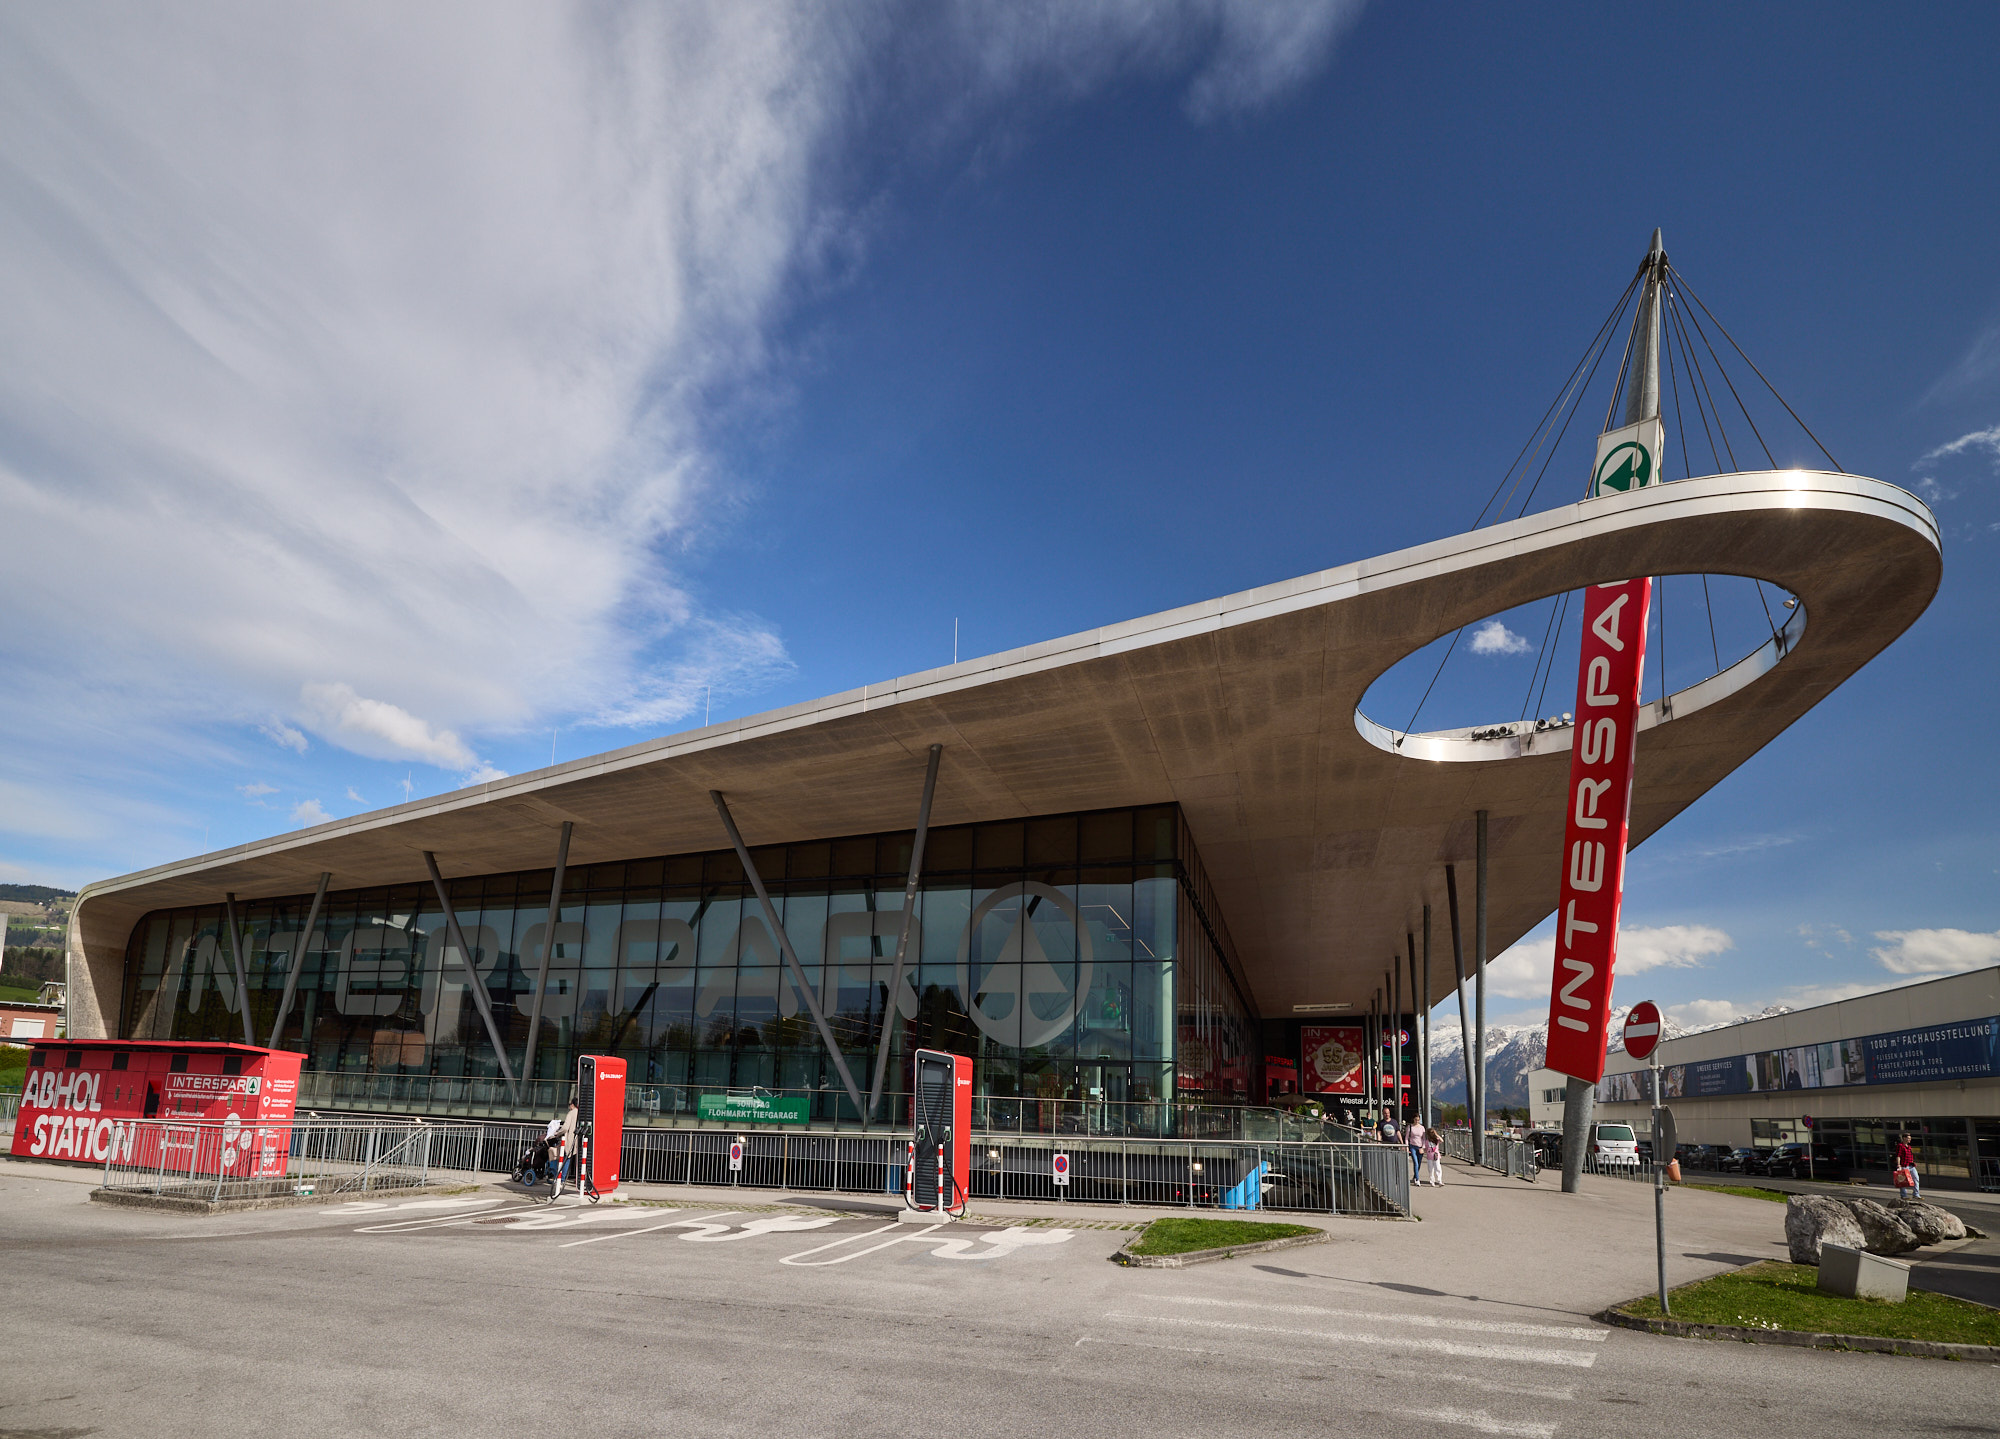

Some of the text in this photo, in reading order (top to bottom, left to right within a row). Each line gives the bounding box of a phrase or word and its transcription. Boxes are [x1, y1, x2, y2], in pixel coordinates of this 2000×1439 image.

[1557, 580, 1630, 1033] INTERSPA
[163, 910, 925, 1020] INTERSPAR
[1870, 1038, 1888, 1050] 1000
[1902, 1024, 1991, 1046] FACHAUSSTELLUNG
[1322, 1046, 1348, 1064] 55
[1928, 1057, 1943, 1065] TORE
[1947, 1063, 1992, 1073] NATURSTEINE
[21, 1070, 102, 1112] ABHOL
[172, 1076, 247, 1091] INTERSPAR
[1340, 1097, 1364, 1105] Wiestal
[708, 1108, 798, 1120] FLOHMARKT TIEFGARAGE
[30, 1114, 135, 1162] STATION
